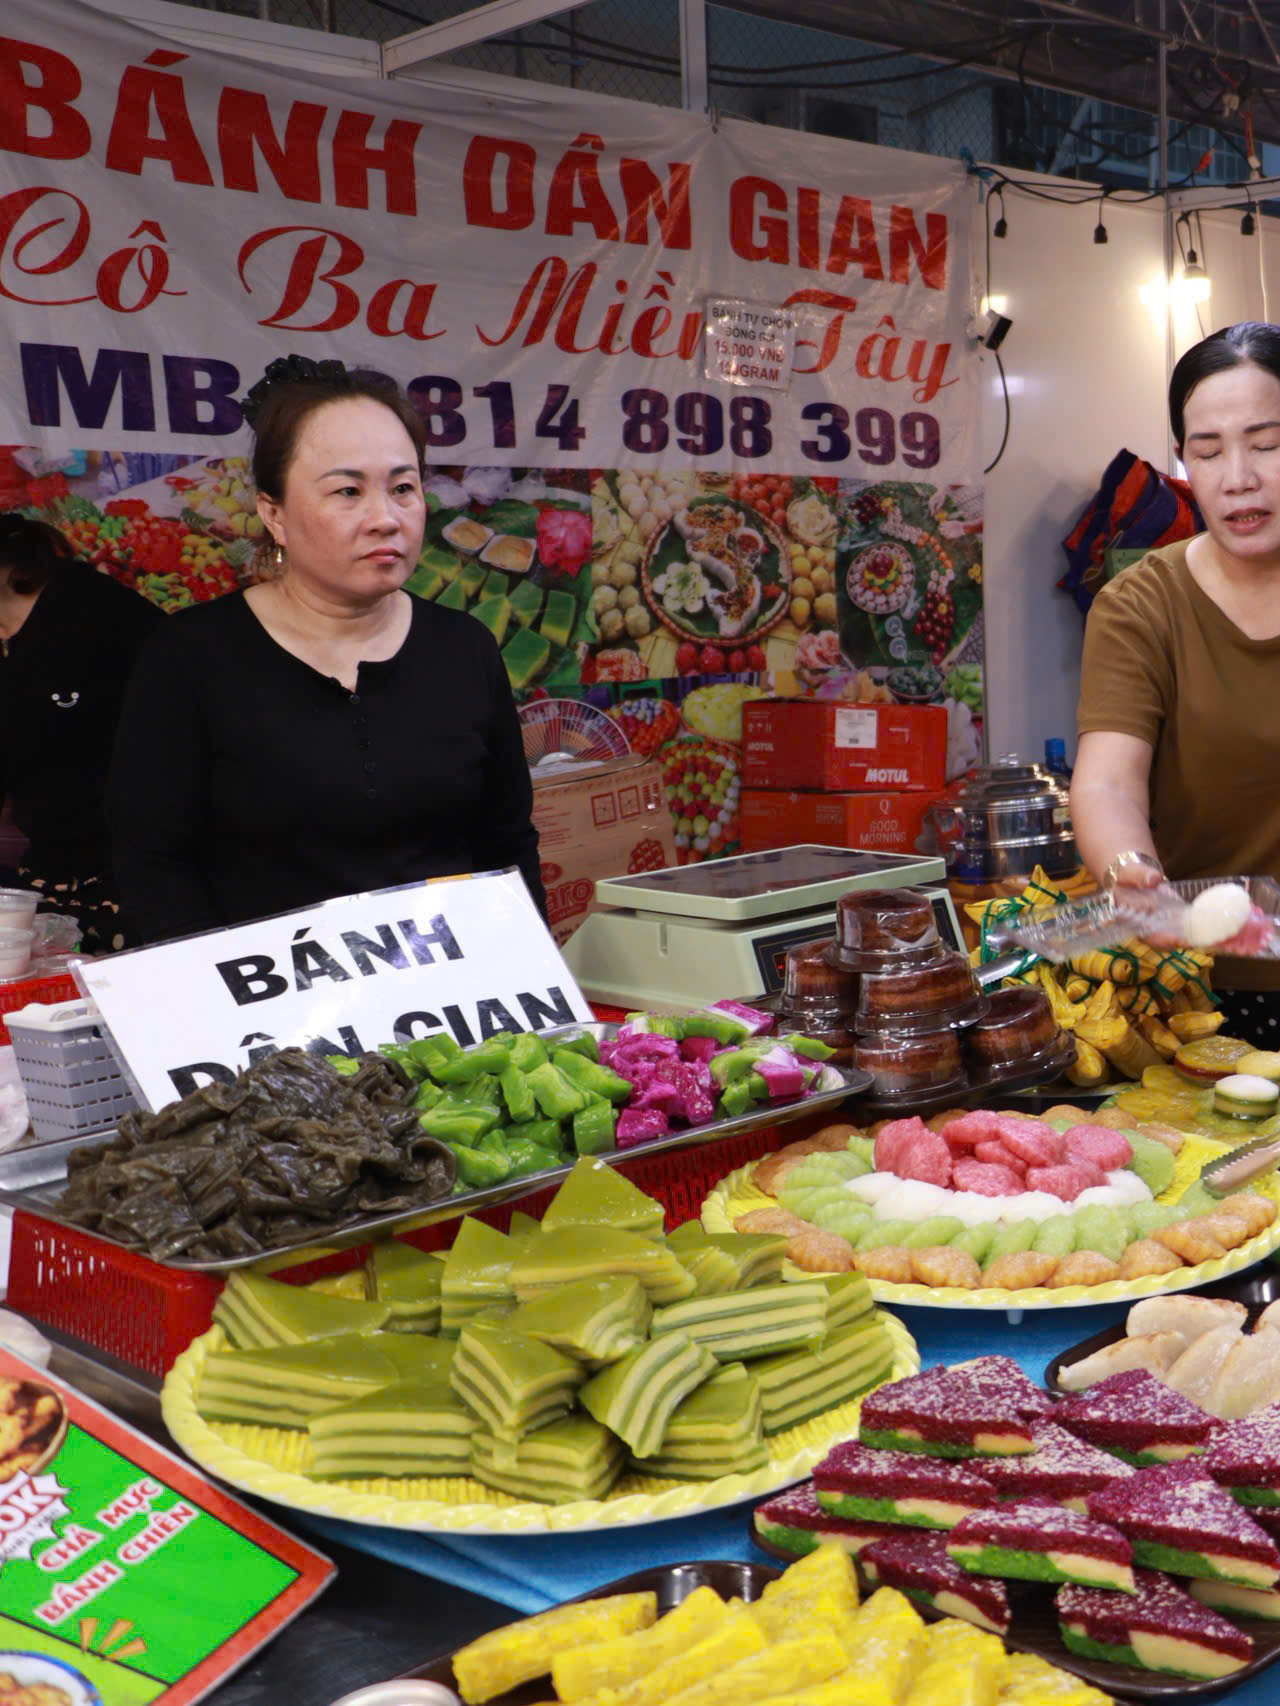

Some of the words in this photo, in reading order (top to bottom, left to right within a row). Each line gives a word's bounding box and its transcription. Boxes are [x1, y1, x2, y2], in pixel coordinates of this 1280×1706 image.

[0, 36, 425, 217] BÁNH
[462, 132, 693, 250] DÂN
[728, 175, 948, 291] GIAN
[0, 186, 189, 314] Cô
[237, 226, 448, 341] Ba
[781, 288, 961, 404] Tây
[352, 370, 587, 452] 814
[621, 388, 773, 459] 898
[800, 402, 941, 469] 399
[864, 768, 910, 784] MOTUL
[860, 831, 907, 845] MORNING
[870, 819, 899, 832] GOOD
[215, 913, 466, 1006] BÁNH
[100, 1479, 162, 1527] MỰC
[38, 1563, 120, 1622] BÁNH
[120, 1503, 195, 1562] CHIÊN
